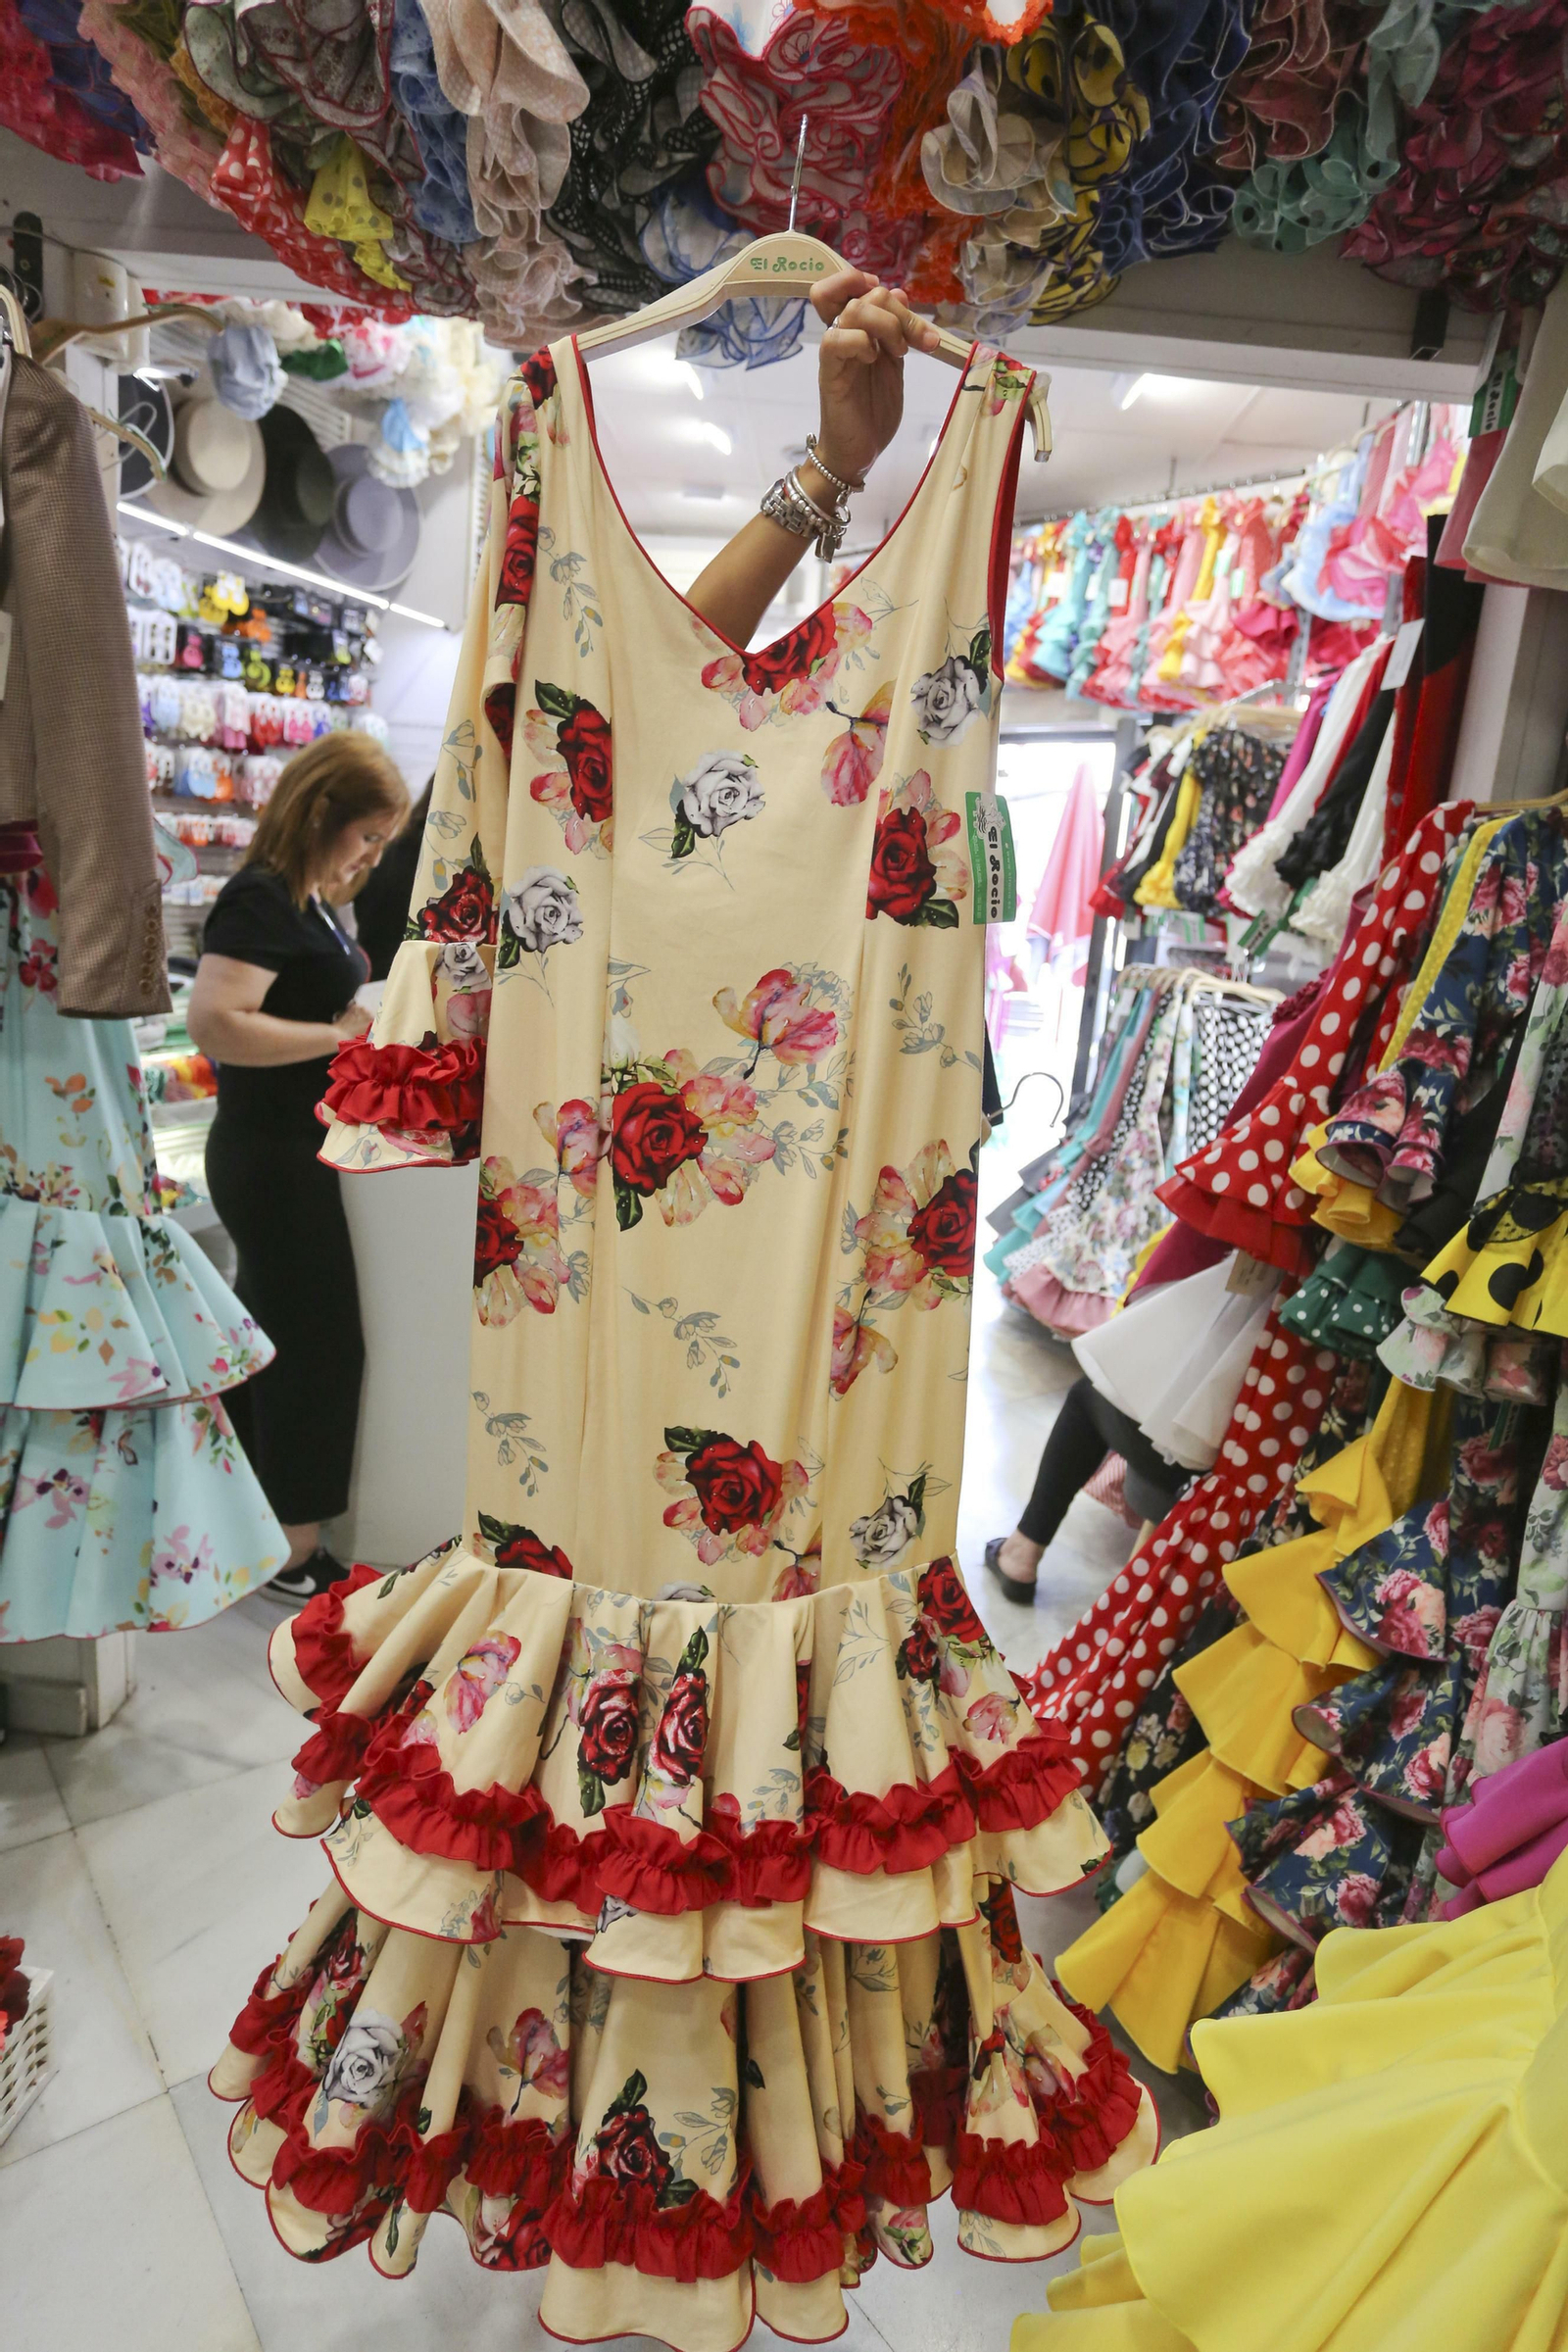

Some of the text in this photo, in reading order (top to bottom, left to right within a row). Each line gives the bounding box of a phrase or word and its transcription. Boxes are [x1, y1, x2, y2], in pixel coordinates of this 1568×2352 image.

[750, 257, 824, 272] El Rocio
[988, 826, 1000, 918] El Rocio
